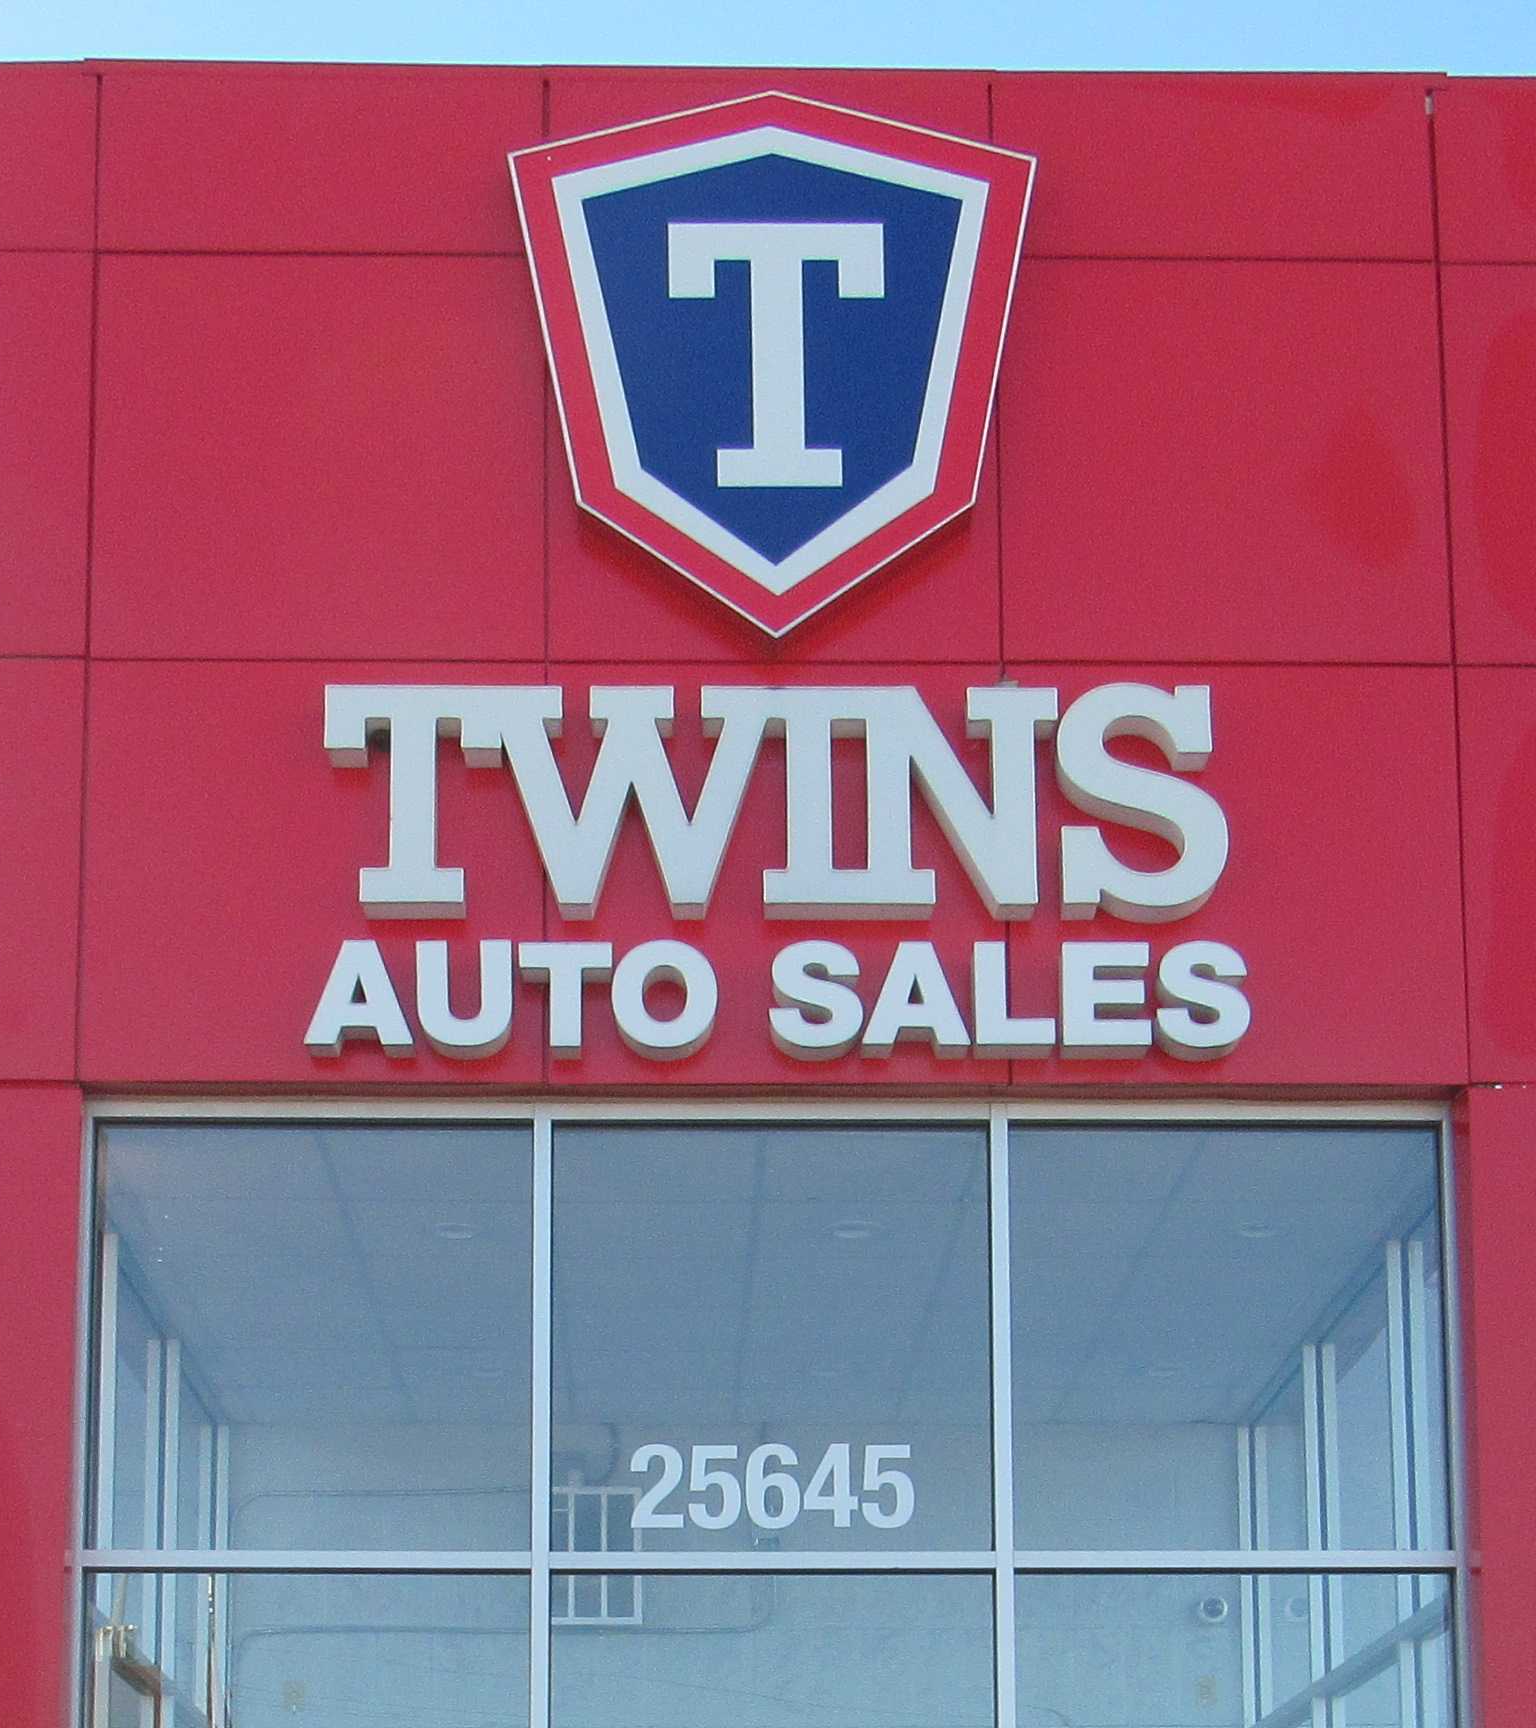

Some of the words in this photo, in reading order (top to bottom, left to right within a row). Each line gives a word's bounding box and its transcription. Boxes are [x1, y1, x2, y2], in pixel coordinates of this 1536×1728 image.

[668, 223, 884, 487] T
[324, 681, 1229, 923] TWINS
[304, 939, 719, 1060] AUTO
[767, 939, 1252, 1060] SALES
[630, 1443, 915, 1529] 25645
